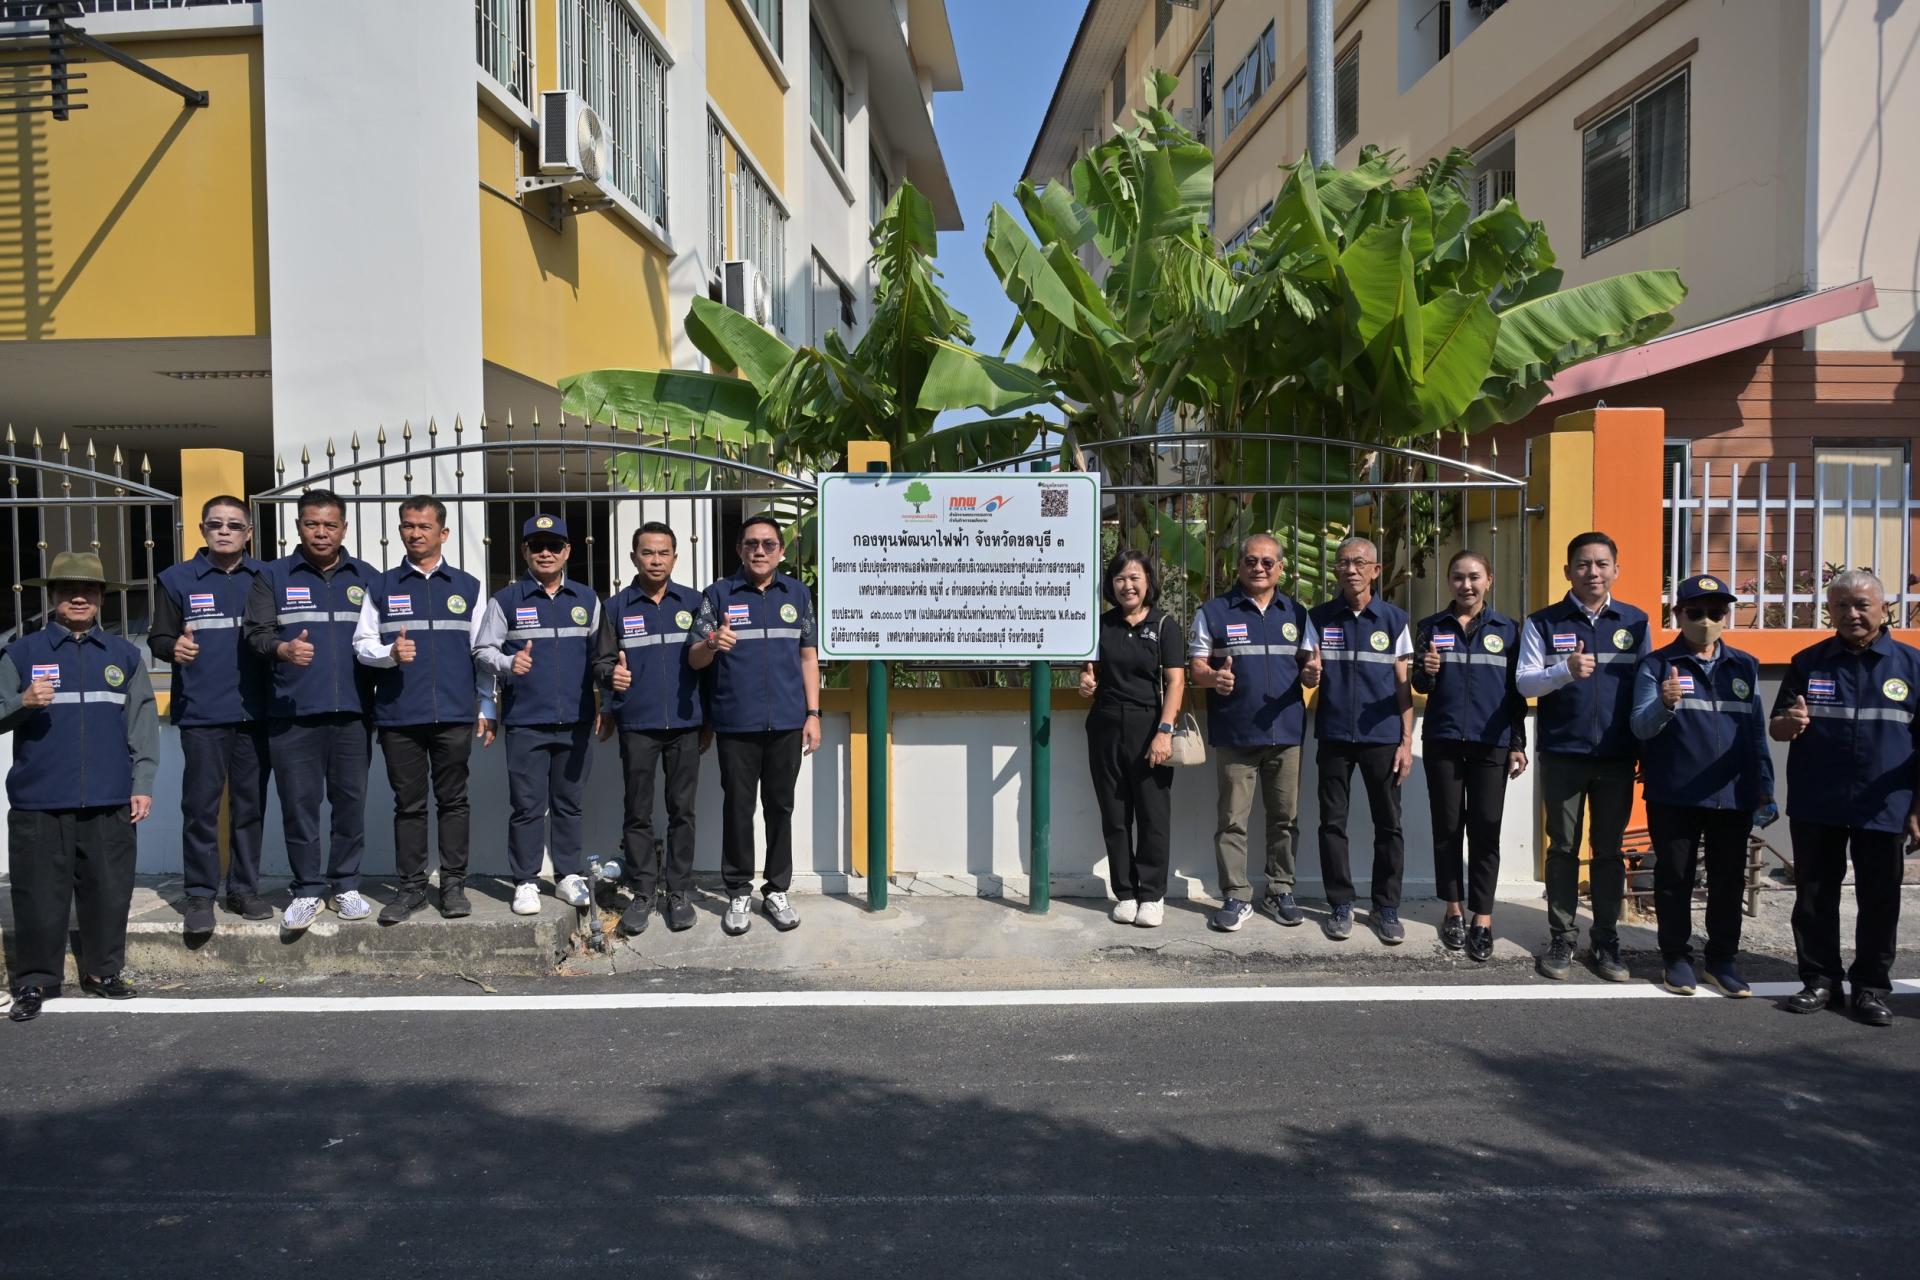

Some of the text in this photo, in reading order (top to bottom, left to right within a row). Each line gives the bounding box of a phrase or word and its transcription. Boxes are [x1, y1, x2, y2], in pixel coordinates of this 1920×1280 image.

[949, 496, 976, 507] กกพ
[852, 526, 1065, 554] กองทุนพัฒนาไฟฟ้า จังหวัดชลบุรี ๓
[832, 556, 857, 573] โครงการ
[929, 577, 944, 603] หมู่ที่
[999, 580, 1033, 597] อำเภอเมือง
[1034, 580, 1071, 602] จังหวัดชลบุรี
[904, 609, 917, 620] บาท
[1018, 605, 1057, 620] ปีงบประมาณ
[956, 627, 1006, 648] อำเภอเมืองชลบุรี
[1007, 628, 1044, 648] จังหวัดชลบุรี
